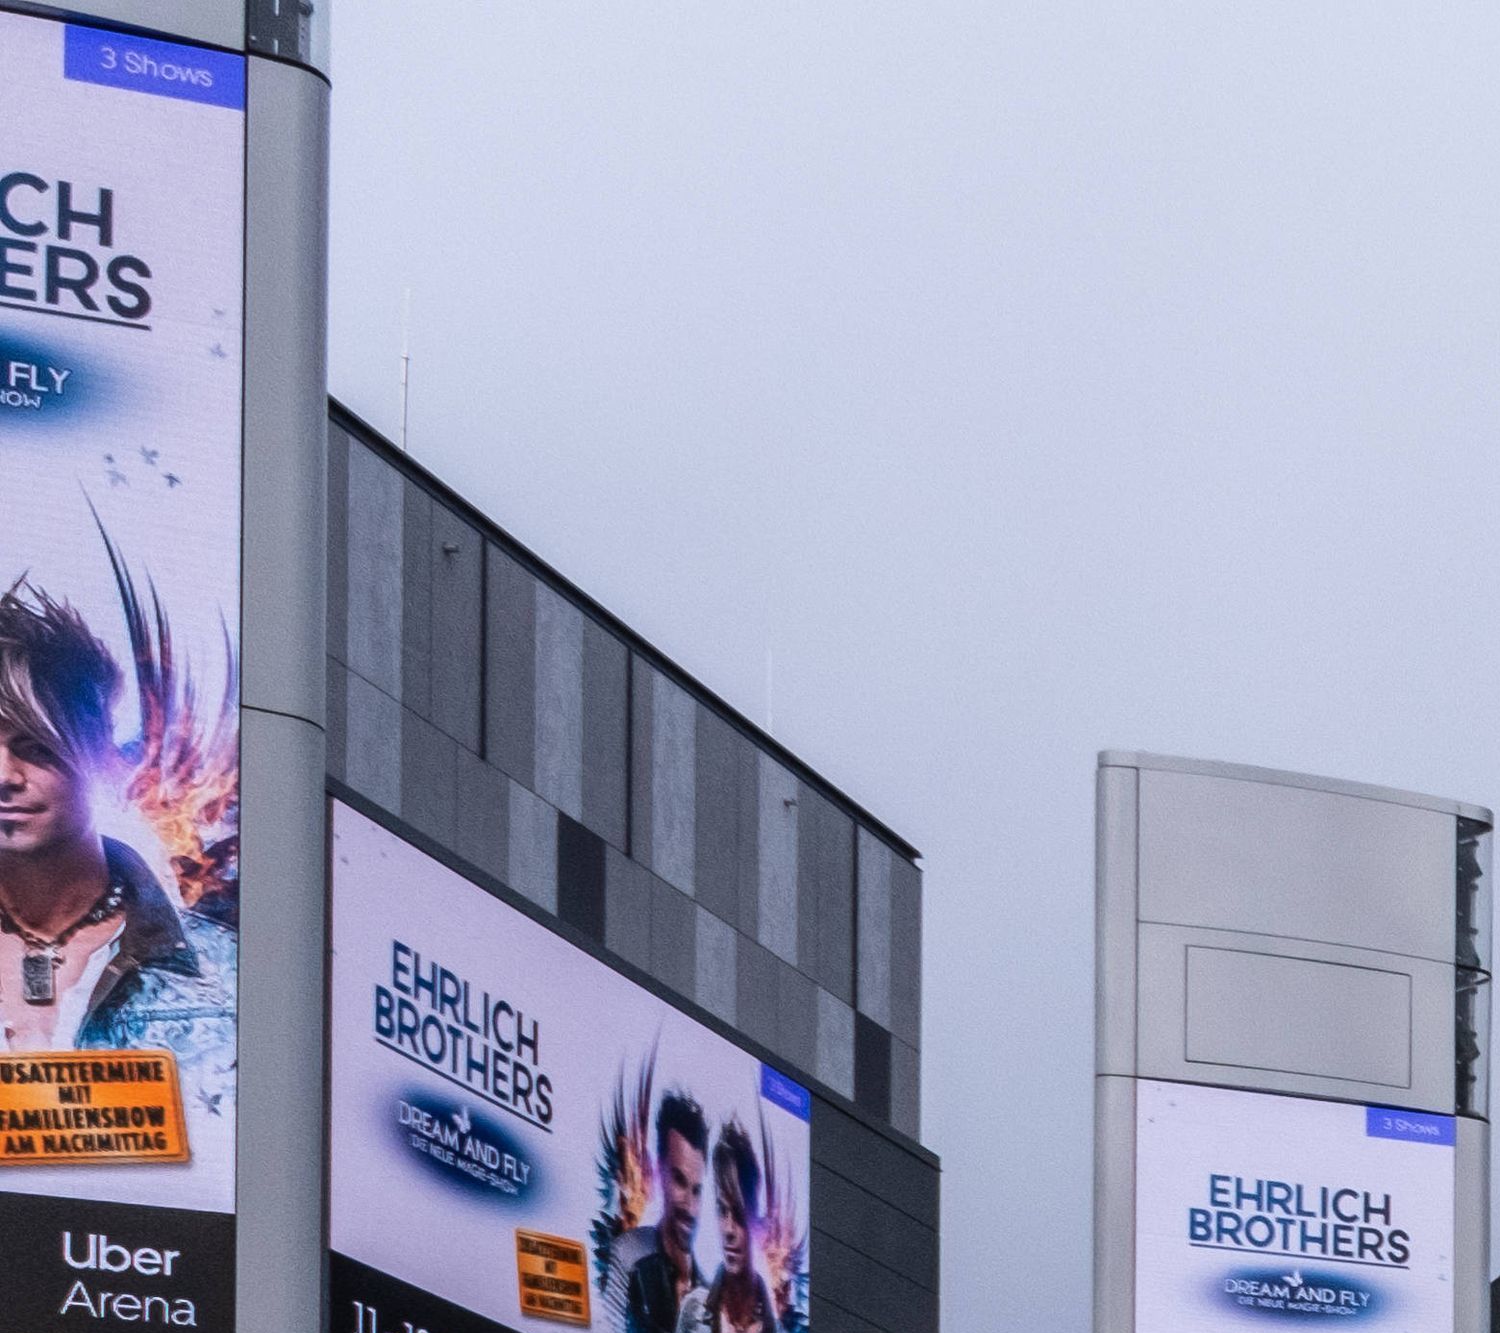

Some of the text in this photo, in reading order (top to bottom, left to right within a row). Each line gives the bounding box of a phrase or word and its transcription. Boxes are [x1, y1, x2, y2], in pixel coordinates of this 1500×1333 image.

[100, 47, 214, 88] 3 Shows
[10, 361, 71, 394] FLY
[393, 939, 539, 1066] EHRLICH
[375, 984, 553, 1124] BROTHERS
[58, 1085, 91, 1104] MIT
[5, 1132, 167, 1153] AM NACHMITTAG
[399, 1100, 531, 1185] DREAM AND FLY
[1209, 1174, 1391, 1226] EHRLICH
[62, 1231, 181, 1276] Uber
[1189, 1207, 1410, 1264] BROTHERS
[59, 1280, 197, 1326] Arena
[1225, 1279, 1371, 1307] DREAM AND FLY
